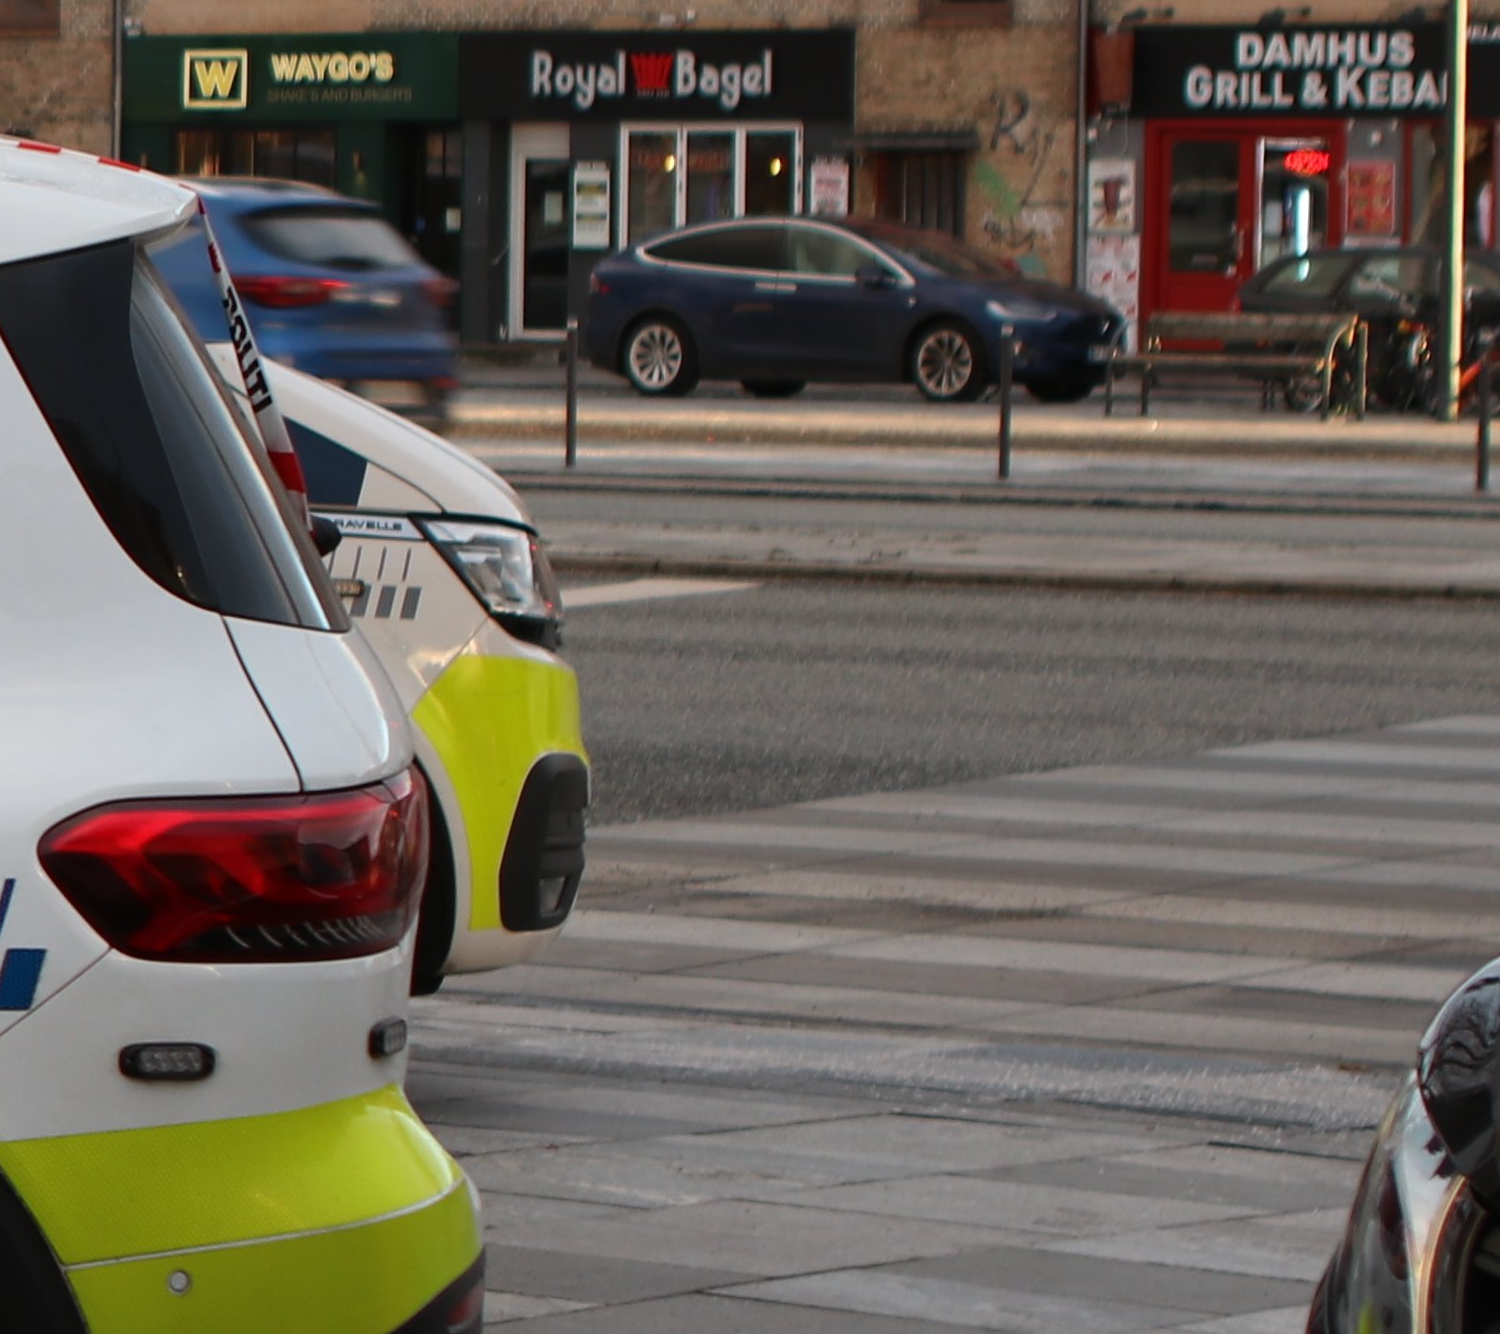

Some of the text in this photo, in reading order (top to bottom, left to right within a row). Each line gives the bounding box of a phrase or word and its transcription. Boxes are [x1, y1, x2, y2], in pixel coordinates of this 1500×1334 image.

[271, 53, 394, 82] WAYGO'S
[1238, 32, 1415, 68] DAMHUS
[194, 60, 238, 98] W
[532, 48, 772, 109] Royal Bagel
[1302, 71, 1328, 106] &
[334, 519, 402, 531] RAVELLE
